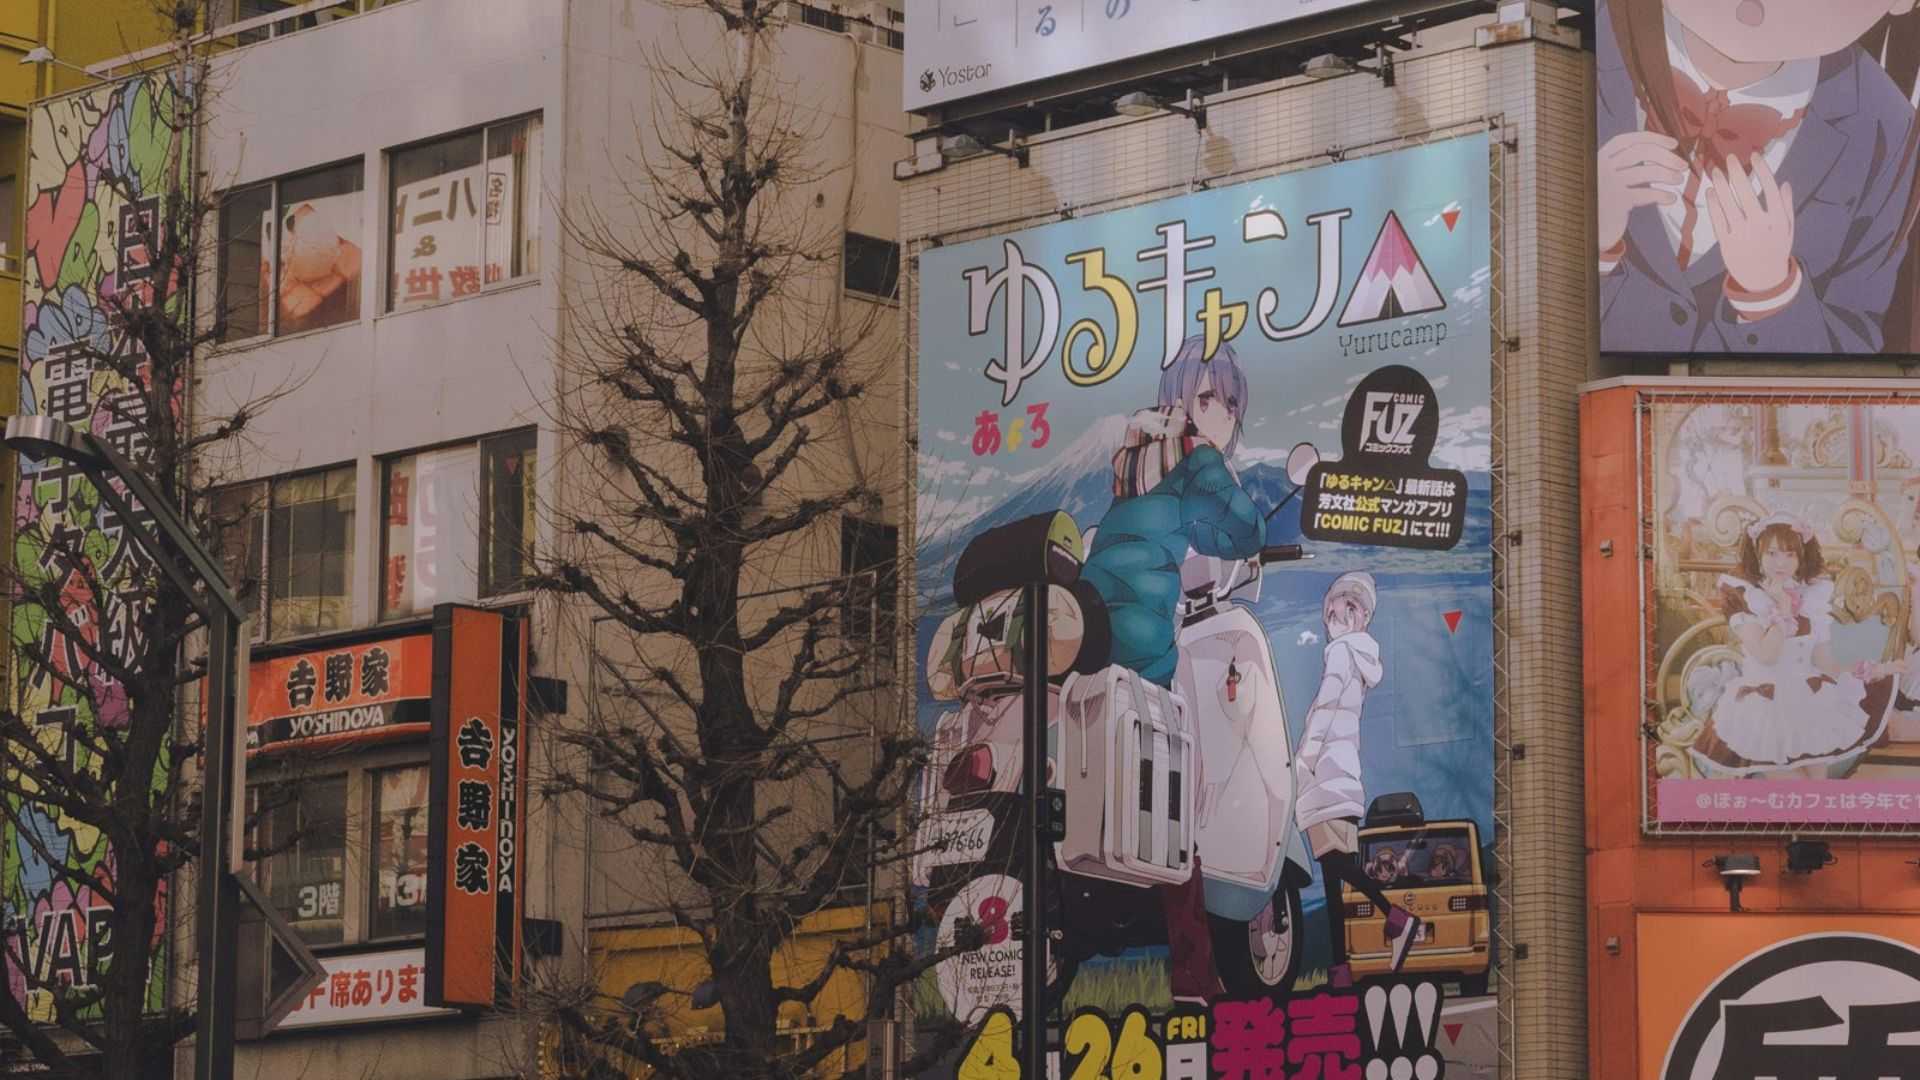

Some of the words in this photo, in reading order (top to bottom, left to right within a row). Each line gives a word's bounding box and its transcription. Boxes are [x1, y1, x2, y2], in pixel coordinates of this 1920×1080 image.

[938, 62, 992, 88] Yostar
[1338, 320, 1447, 357] Yurucamp
[1393, 393, 1426, 404] COMIC
[1359, 391, 1424, 453] FUZ
[1318, 493, 1453, 518] 芳文社公式マンガアプリ
[287, 648, 389, 710] 吉野家
[289, 705, 385, 738] YOSHINOYA
[455, 716, 493, 896] 吉野家
[498, 727, 516, 893] YOSHINOYA
[297, 882, 340, 918] 3階
[14, 906, 117, 993] VAP
[293, 964, 426, 1012] 席ありま
[970, 964, 1016, 980] RELEASE!
[1166, 1014, 1207, 1041] FRI
